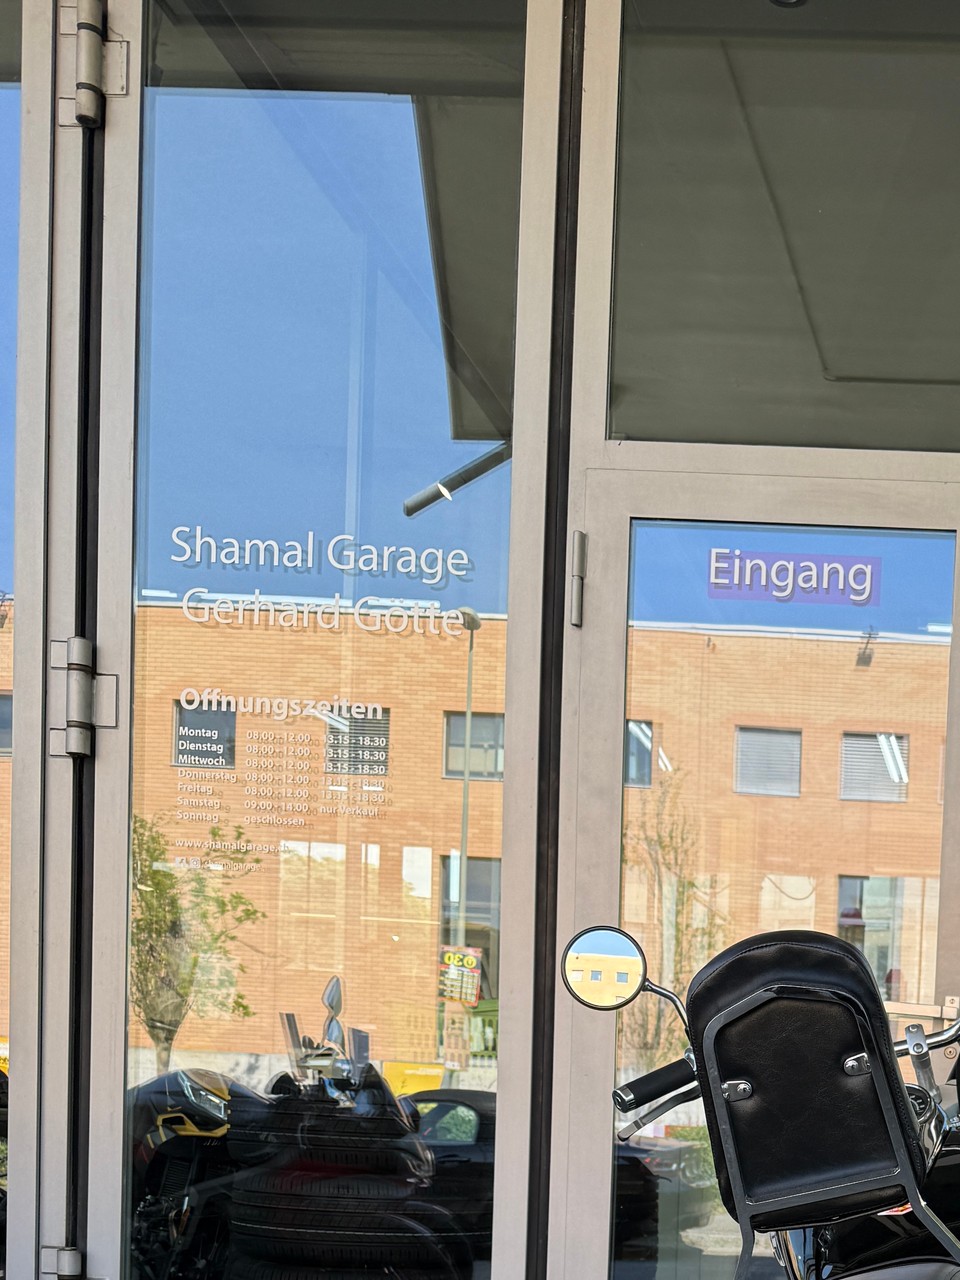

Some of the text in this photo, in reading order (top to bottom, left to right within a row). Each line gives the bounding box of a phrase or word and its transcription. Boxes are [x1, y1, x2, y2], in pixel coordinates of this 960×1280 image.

[170, 525, 469, 585] Shamal Garage
[709, 548, 872, 601] Eingang
[182, 587, 464, 636] Gerhard Götte
[179, 726, 218, 740] Montag
[246, 731, 274, 741] 08.00
[283, 732, 311, 742] 12.00
[324, 735, 350, 745] 13.15
[359, 736, 386, 746] 18.30
[179, 740, 224, 754] Dienstag
[246, 745, 274, 755] 08.00
[283, 746, 310, 757] 12.00
[324, 749, 349, 759] 13.15
[358, 750, 386, 761] 18.30
[178, 754, 226, 766] Mittwoch
[245, 758, 273, 769] 08.00
[283, 760, 310, 770] 12.00
[323, 762, 349, 773] 13.15
[358, 764, 385, 775] 18.30
[177, 768, 237, 783] Donnerstag
[245, 772, 273, 782] 08.00
[282, 774, 309, 784] 12.00
[177, 783, 213, 795] Freitag
[244, 786, 273, 797] 08.00
[282, 788, 309, 798] 12.00
[357, 792, 385, 802] 18.30
[176, 796, 221, 809] Samstag
[244, 800, 272, 810] 09.00
[281, 802, 309, 812] 14.00
[320, 805, 337, 814] nur
[339, 805, 379, 817] Verkauf
[176, 810, 305, 826] Sonntag geschlossen
